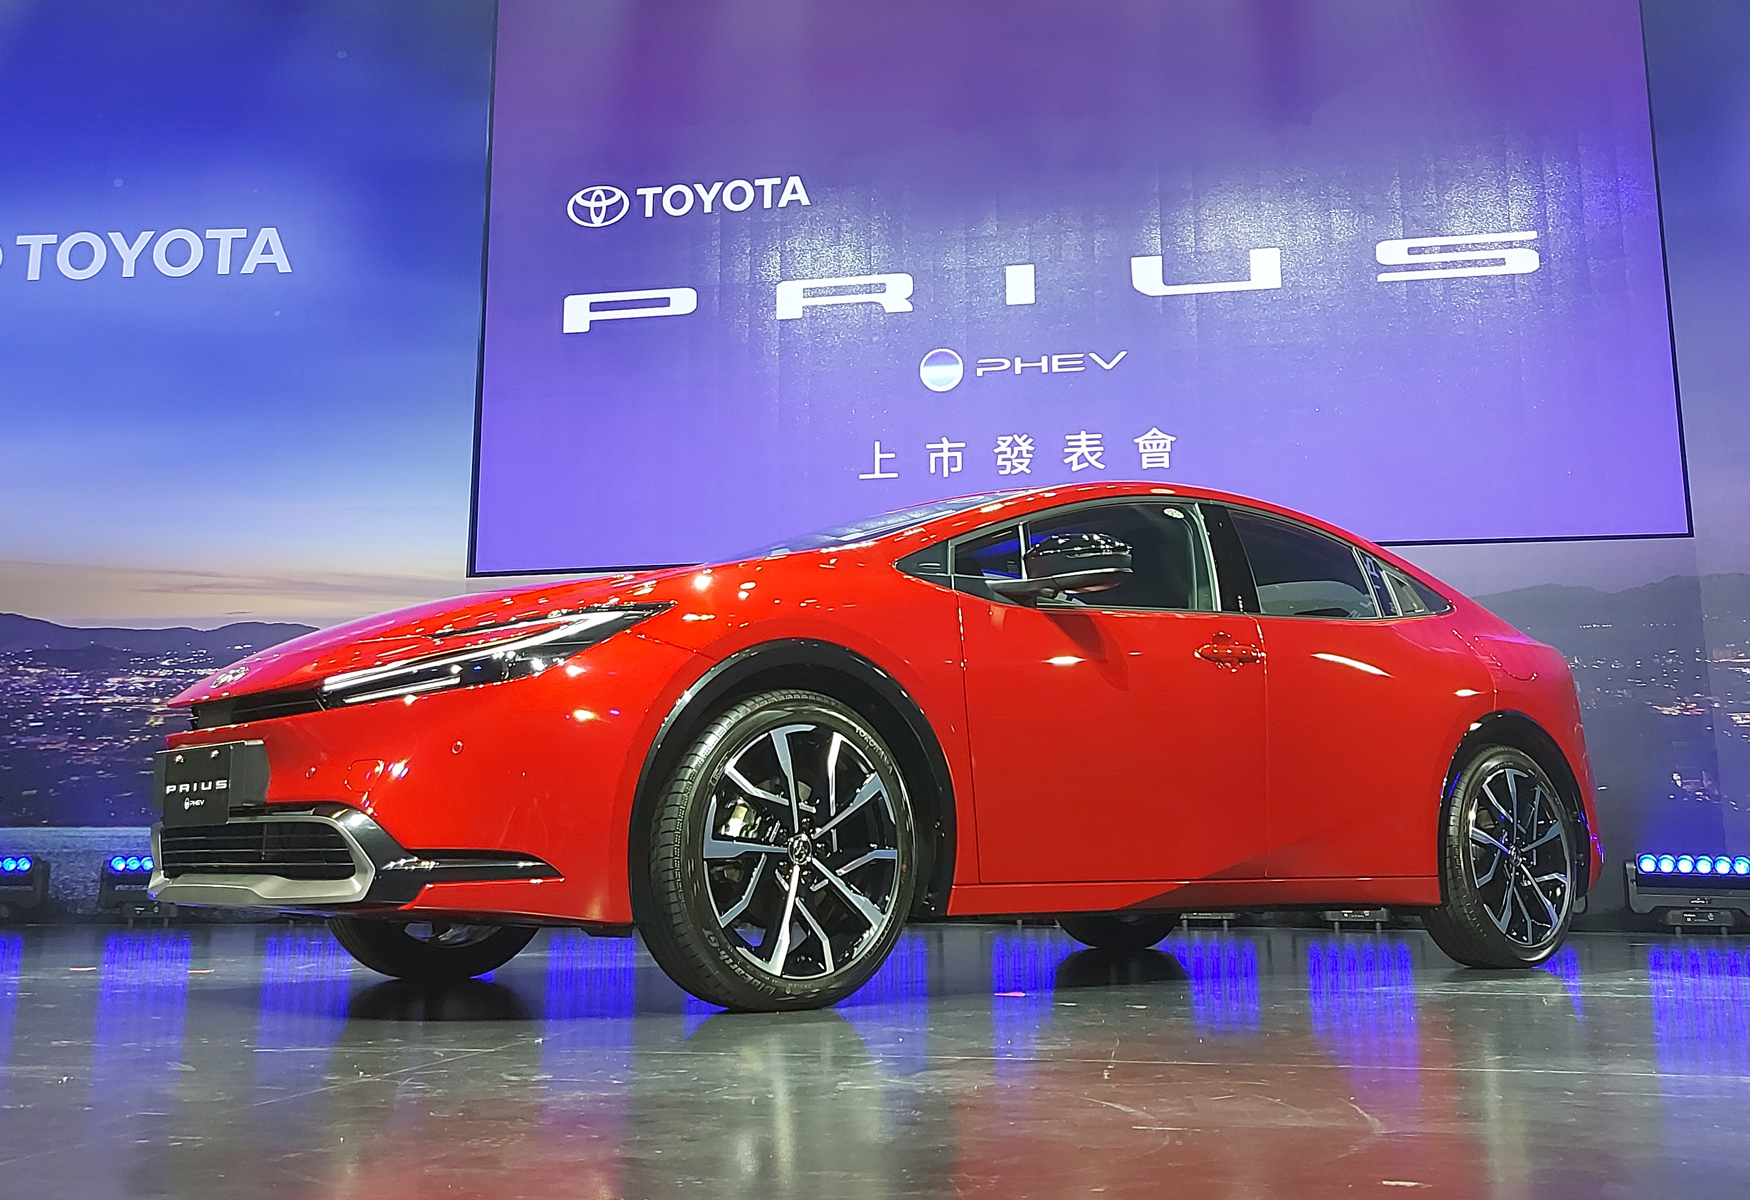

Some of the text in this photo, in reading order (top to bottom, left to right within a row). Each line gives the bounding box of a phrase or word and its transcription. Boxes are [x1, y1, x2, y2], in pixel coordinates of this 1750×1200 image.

[637, 176, 811, 217] TOYOTA
[16, 228, 292, 280] TOYOTA
[564, 231, 1540, 333] PRIUS
[976, 351, 1128, 377] PHEV
[859, 427, 1177, 480] 上市發表會
[166, 780, 228, 795] PRIUS
